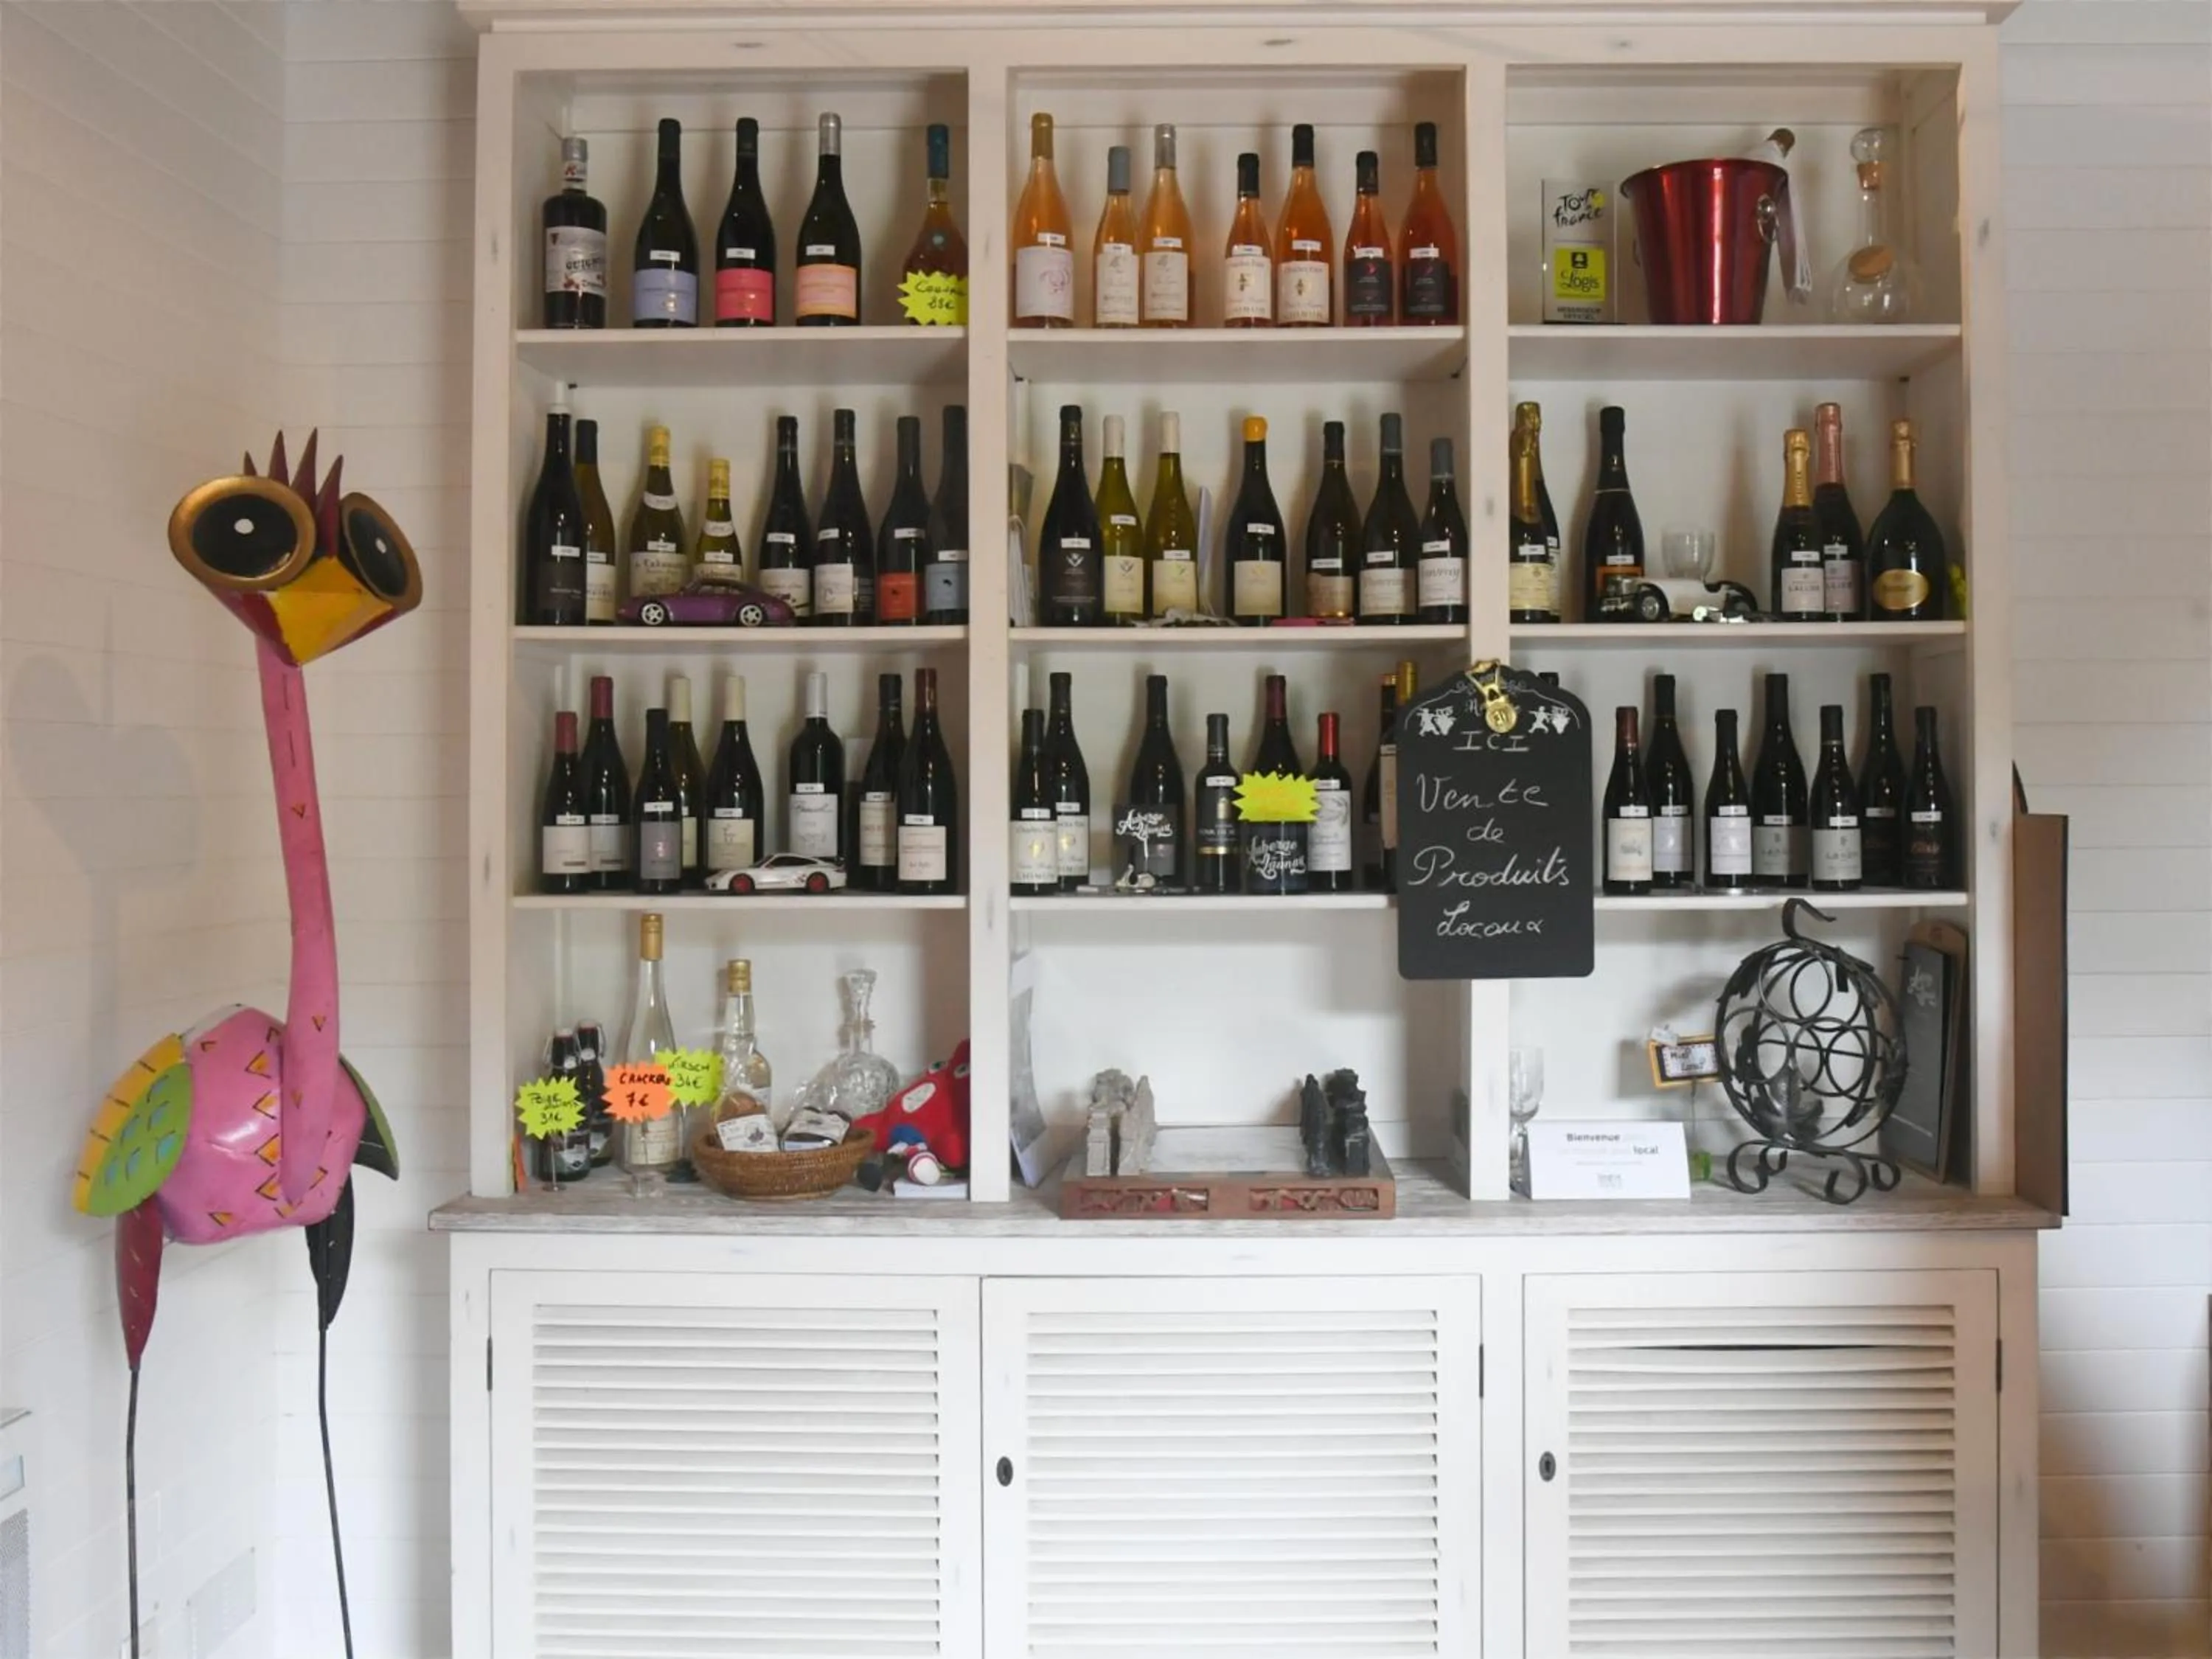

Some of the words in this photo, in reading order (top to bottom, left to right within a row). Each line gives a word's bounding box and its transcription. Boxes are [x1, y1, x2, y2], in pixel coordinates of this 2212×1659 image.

[1453, 730, 1530, 752] ICI
[1416, 773, 1549, 813] Vente
[1467, 818, 1505, 843] de
[1408, 846, 1570, 887] Produits
[1566, 1133, 1621, 1142] Bienvenue
[1633, 1145, 1658, 1155] local
